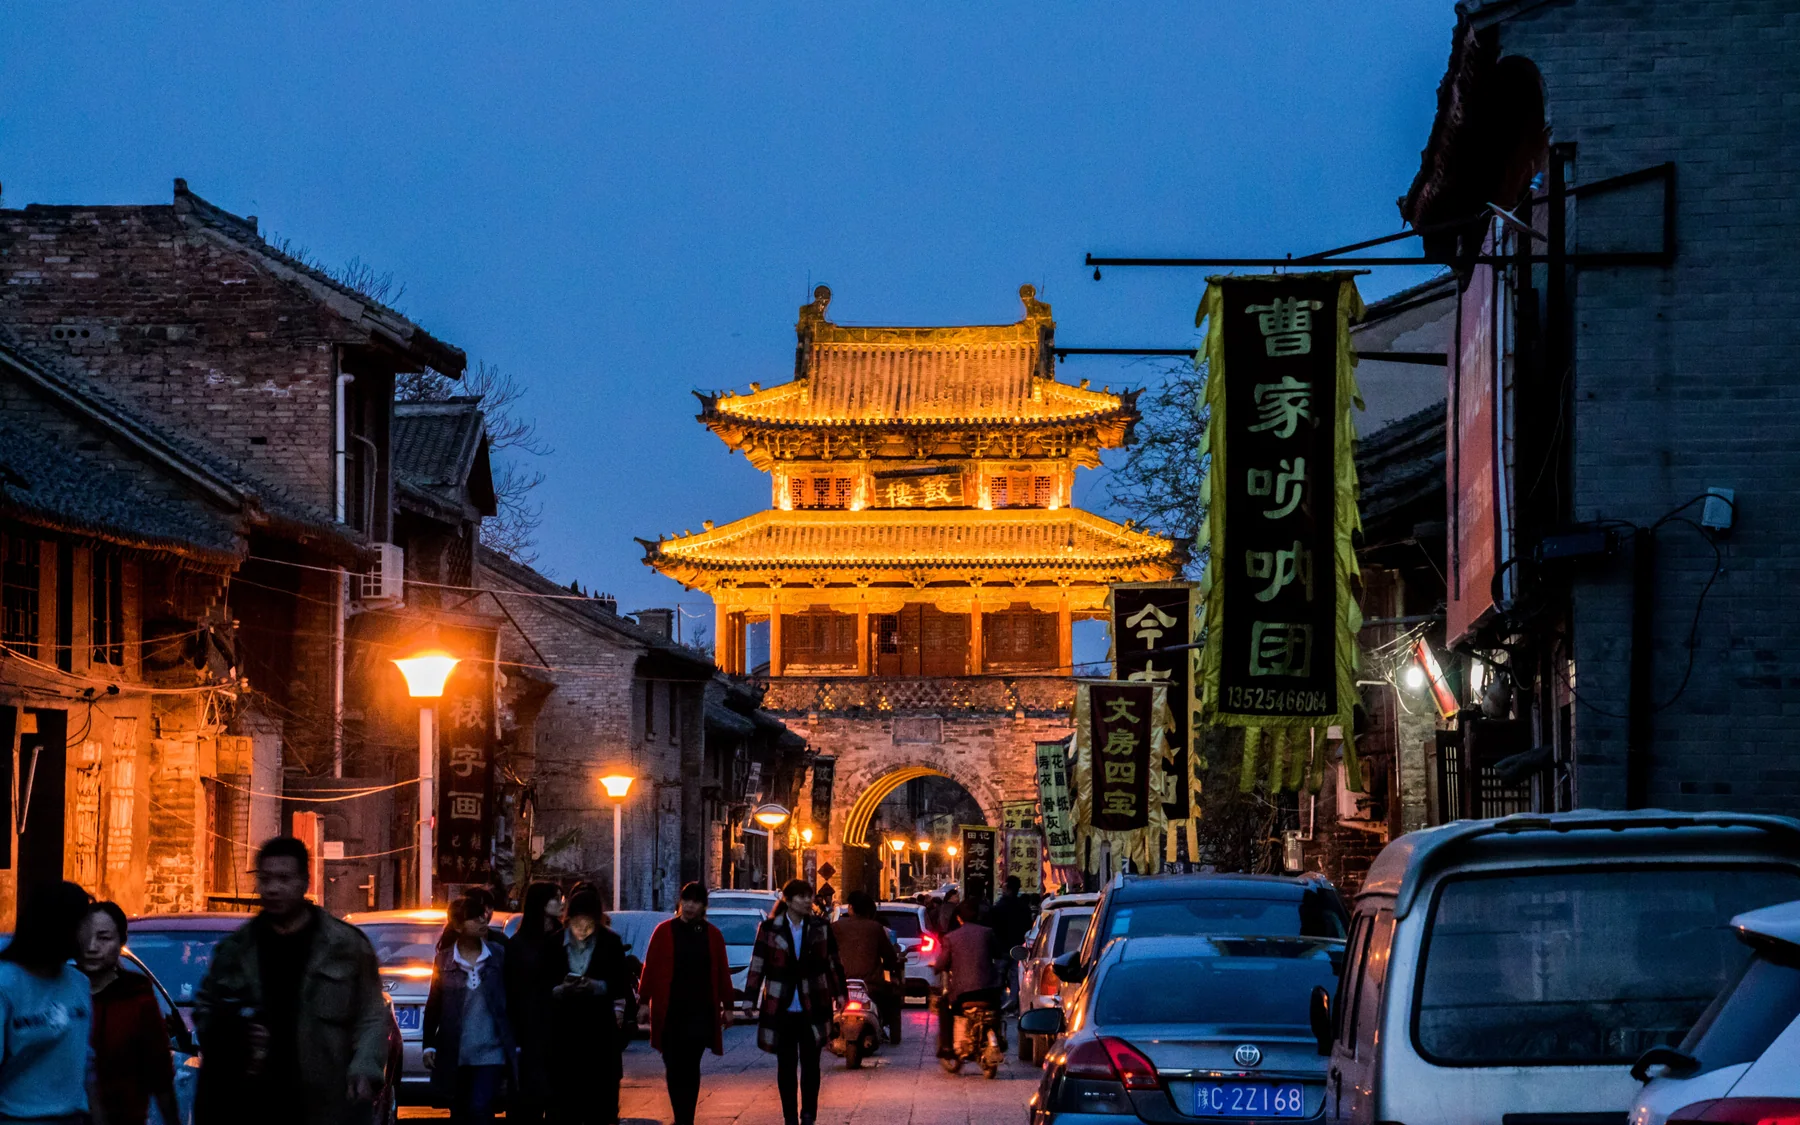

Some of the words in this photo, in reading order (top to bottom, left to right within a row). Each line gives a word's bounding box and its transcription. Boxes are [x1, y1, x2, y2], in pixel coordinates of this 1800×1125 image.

[1227, 686, 1328, 713] 13525466064
[1102, 696, 1141, 818] 文房四宝
[967, 831, 991, 841] 田记
